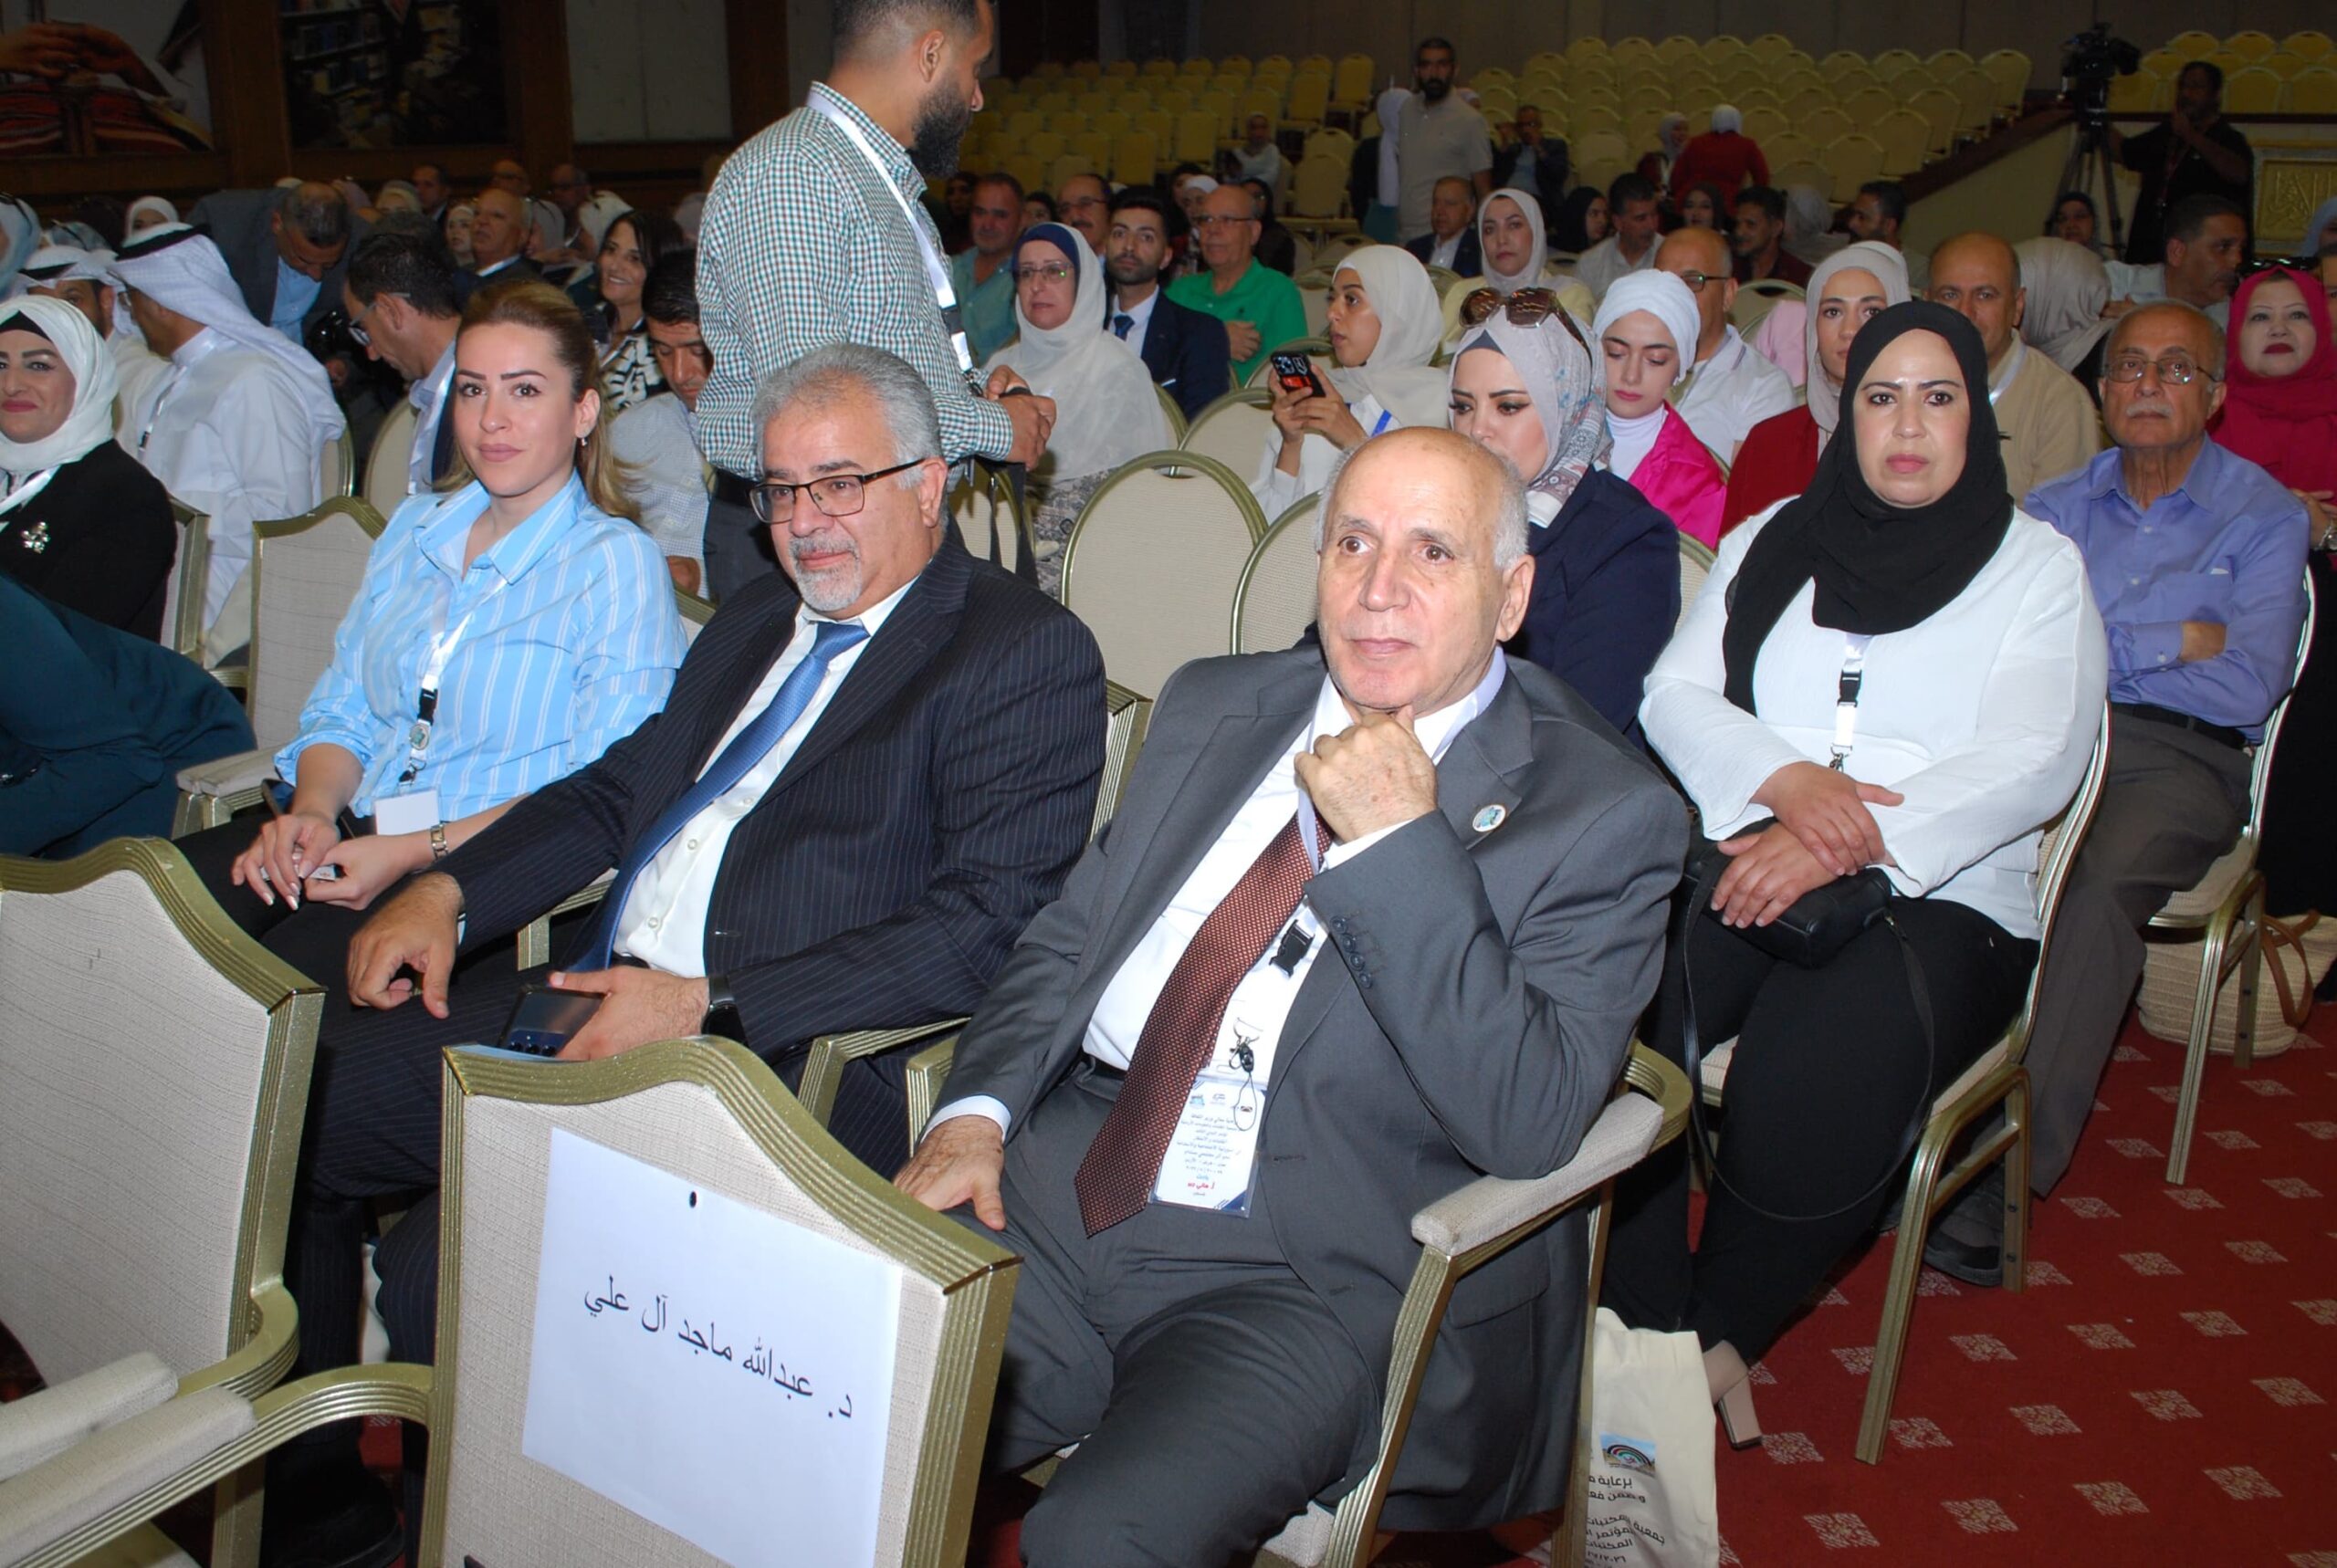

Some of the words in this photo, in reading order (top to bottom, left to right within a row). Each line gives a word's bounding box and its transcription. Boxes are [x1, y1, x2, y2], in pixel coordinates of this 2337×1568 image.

[584, 1275, 629, 1317] علي
[641, 1294, 667, 1333] آل
[678, 1319, 732, 1362] ماجد
[742, 1336, 813, 1400] عبدالله
[828, 1395, 853, 1417] د.
